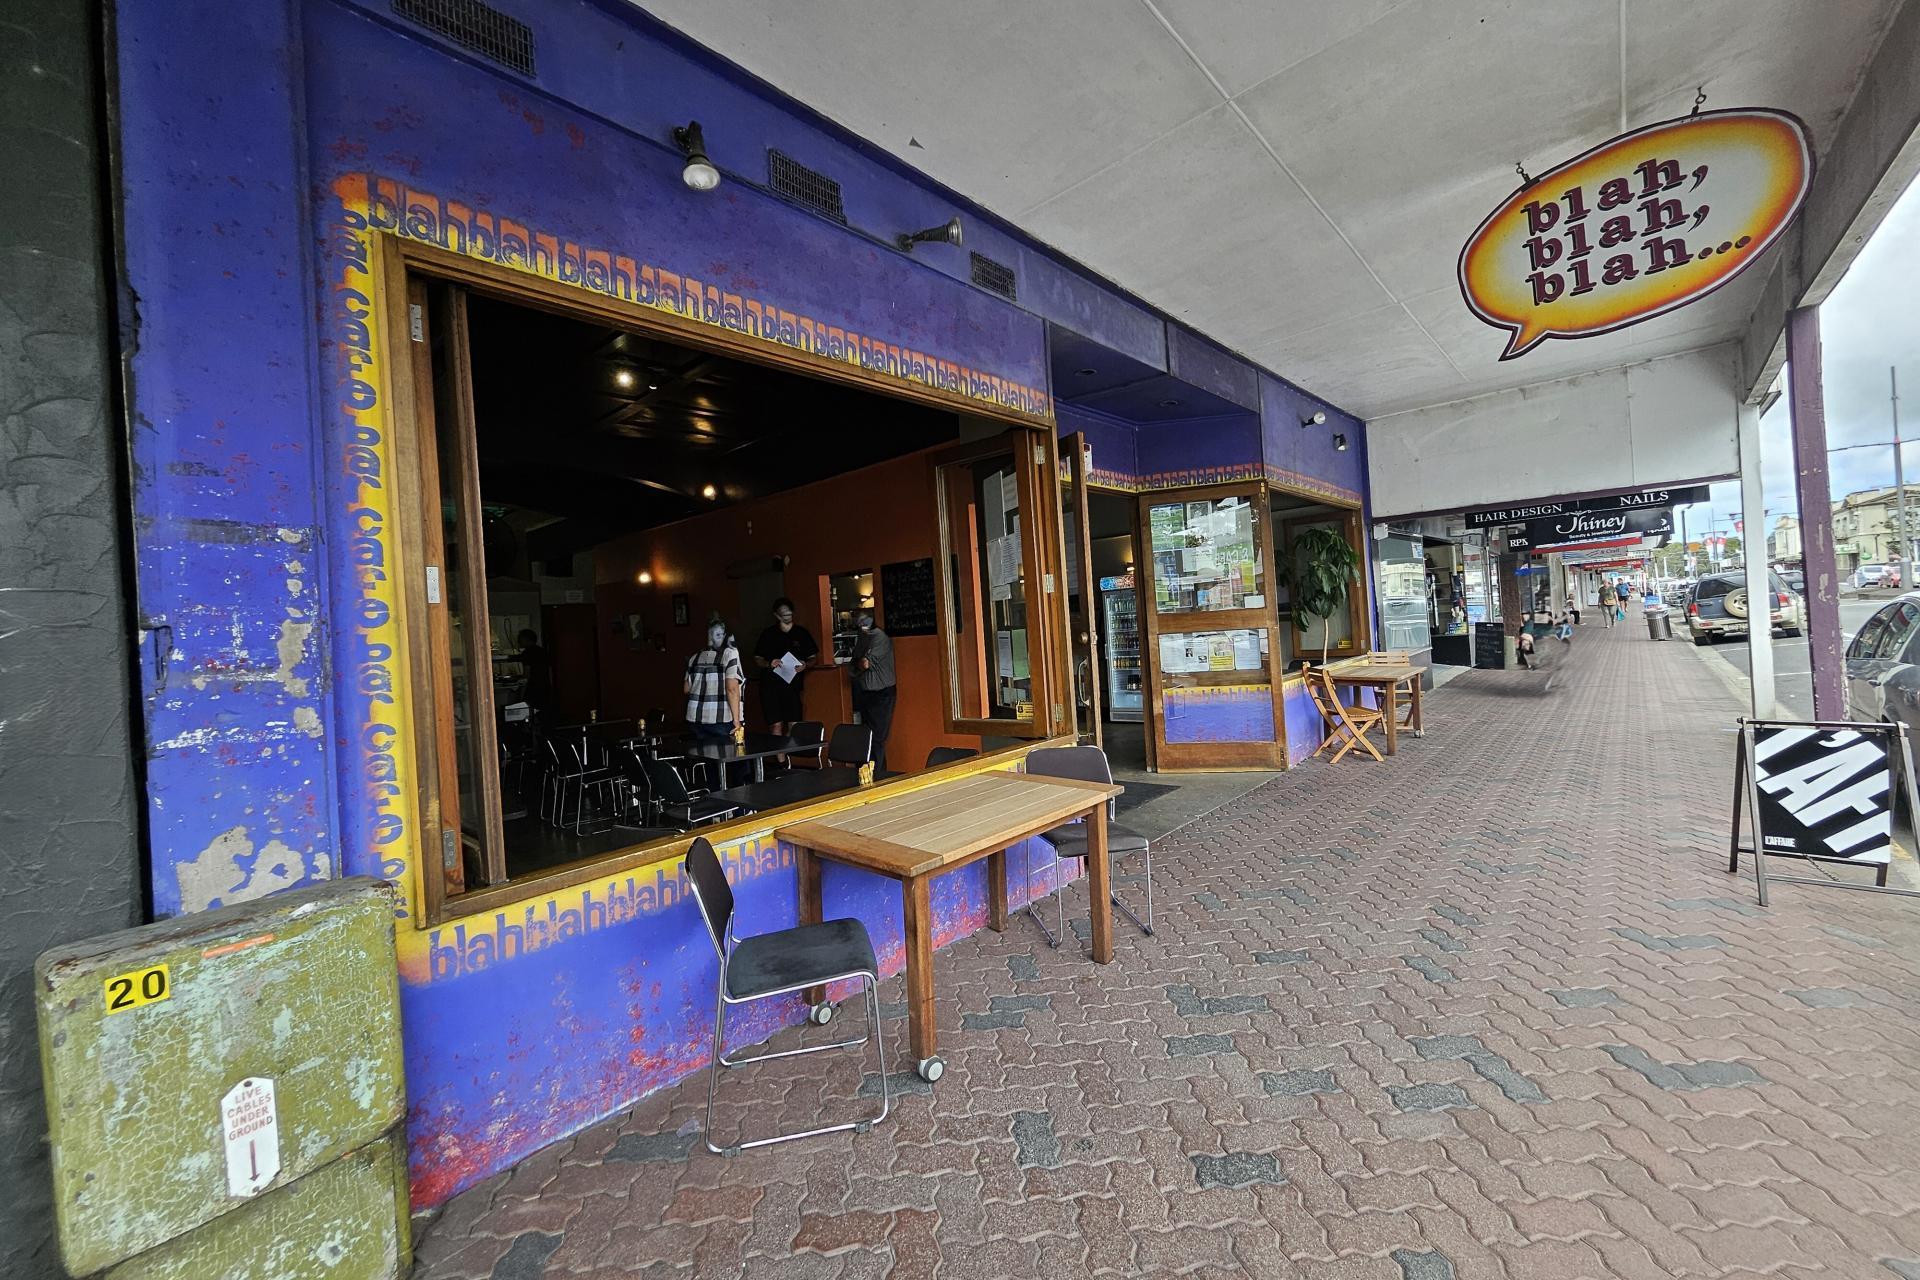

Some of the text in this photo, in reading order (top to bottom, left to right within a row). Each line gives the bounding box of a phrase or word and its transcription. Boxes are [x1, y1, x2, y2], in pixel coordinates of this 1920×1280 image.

[1521, 158, 1709, 237] blah,
[1522, 197, 1711, 270] blah,
[1525, 234, 1752, 306] blah...
[1474, 491, 1669, 523] HAIR DESIGN NAILS
[108, 970, 167, 1010] 20
[227, 1093, 272, 1119] CABLES
[235, 1086, 262, 1105] LIVE
[228, 1115, 273, 1141] GROUND
[232, 1106, 269, 1128] UNDER
